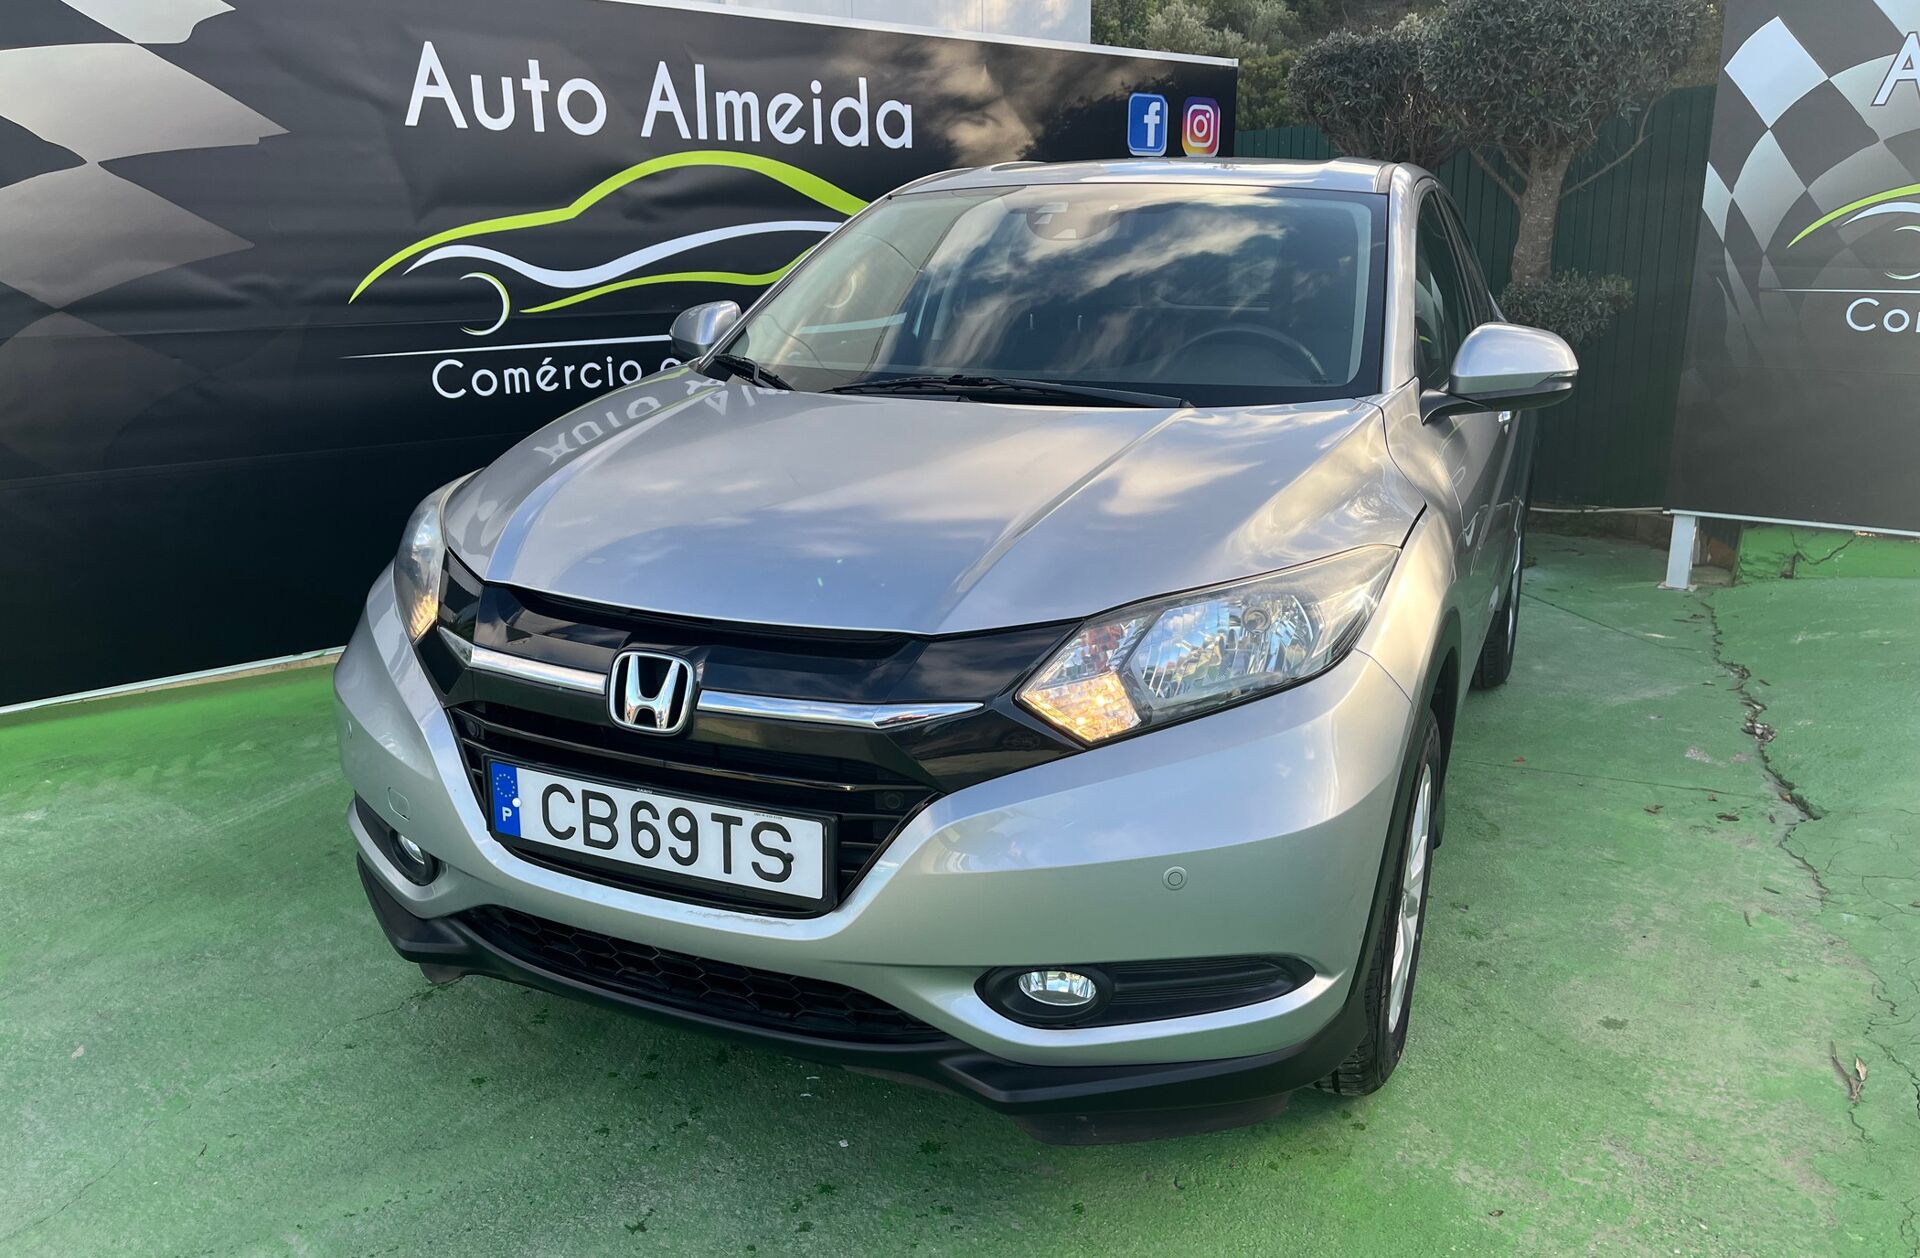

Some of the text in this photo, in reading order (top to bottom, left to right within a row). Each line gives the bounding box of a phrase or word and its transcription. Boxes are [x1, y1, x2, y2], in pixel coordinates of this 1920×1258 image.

[404, 40, 915, 150] Auto Almeida
[1845, 296, 1920, 334] Co
[431, 355, 642, 399] Comércio
[501, 806, 513, 822] P
[541, 783, 794, 884] CB69TS
